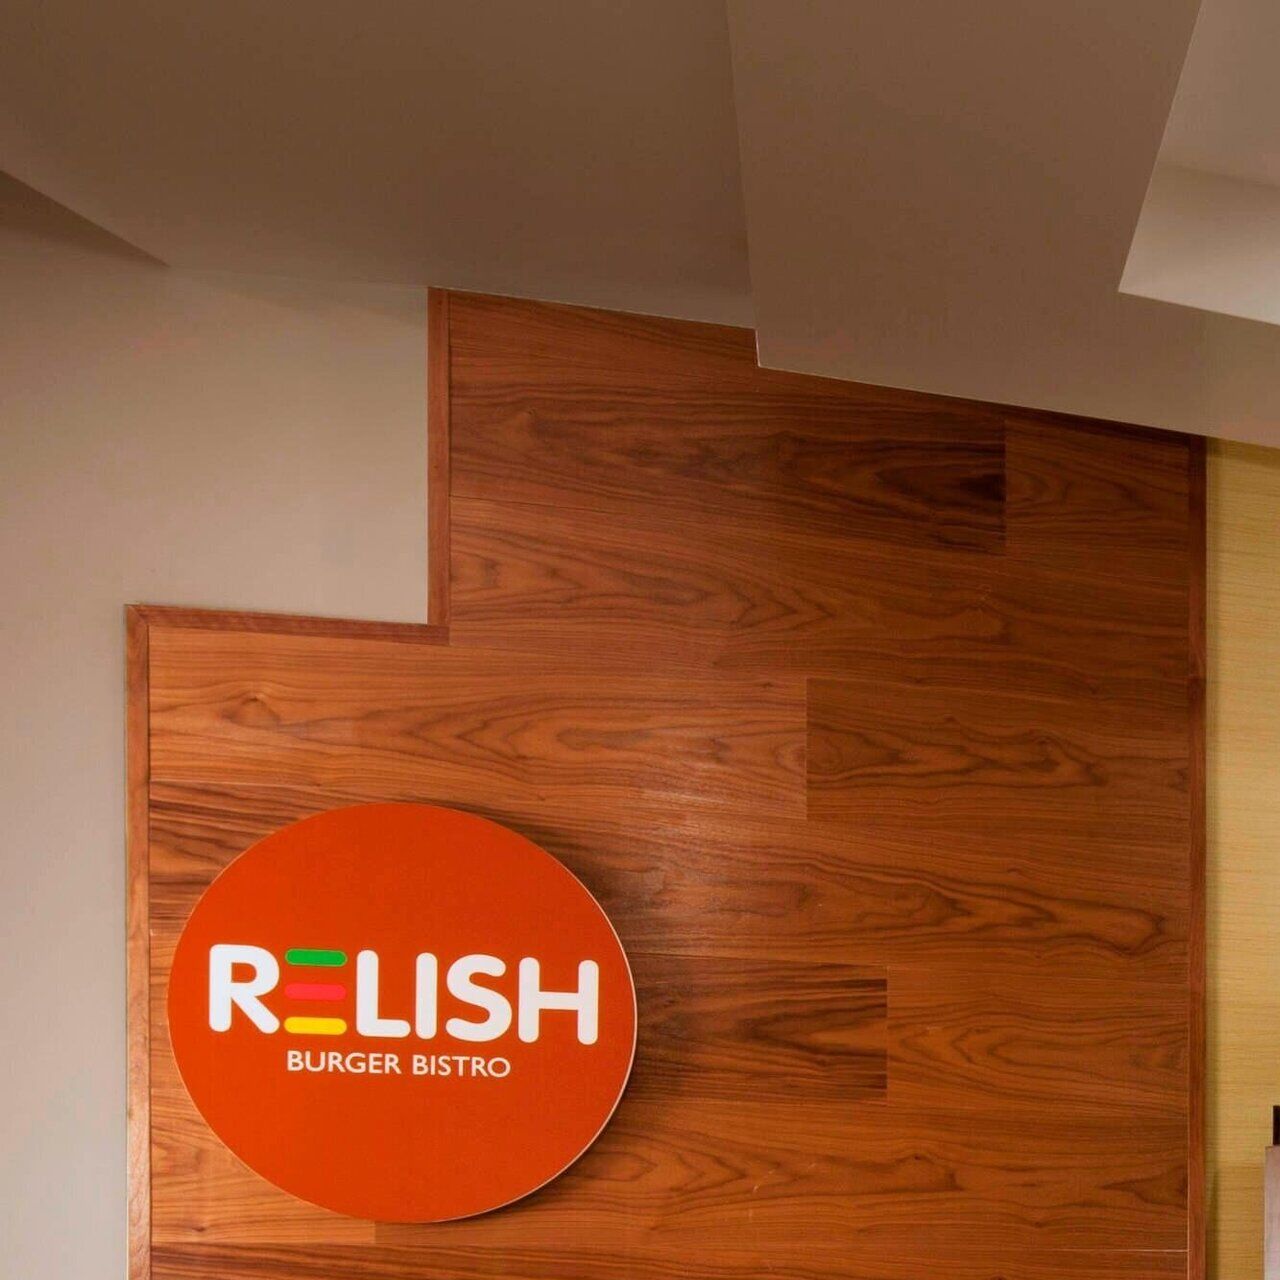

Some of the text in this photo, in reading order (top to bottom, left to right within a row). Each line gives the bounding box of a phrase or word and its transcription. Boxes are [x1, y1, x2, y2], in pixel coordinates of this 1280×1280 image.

[208, 943, 600, 1046] RELISH
[286, 1050, 512, 1079] BURGER BISTRO
